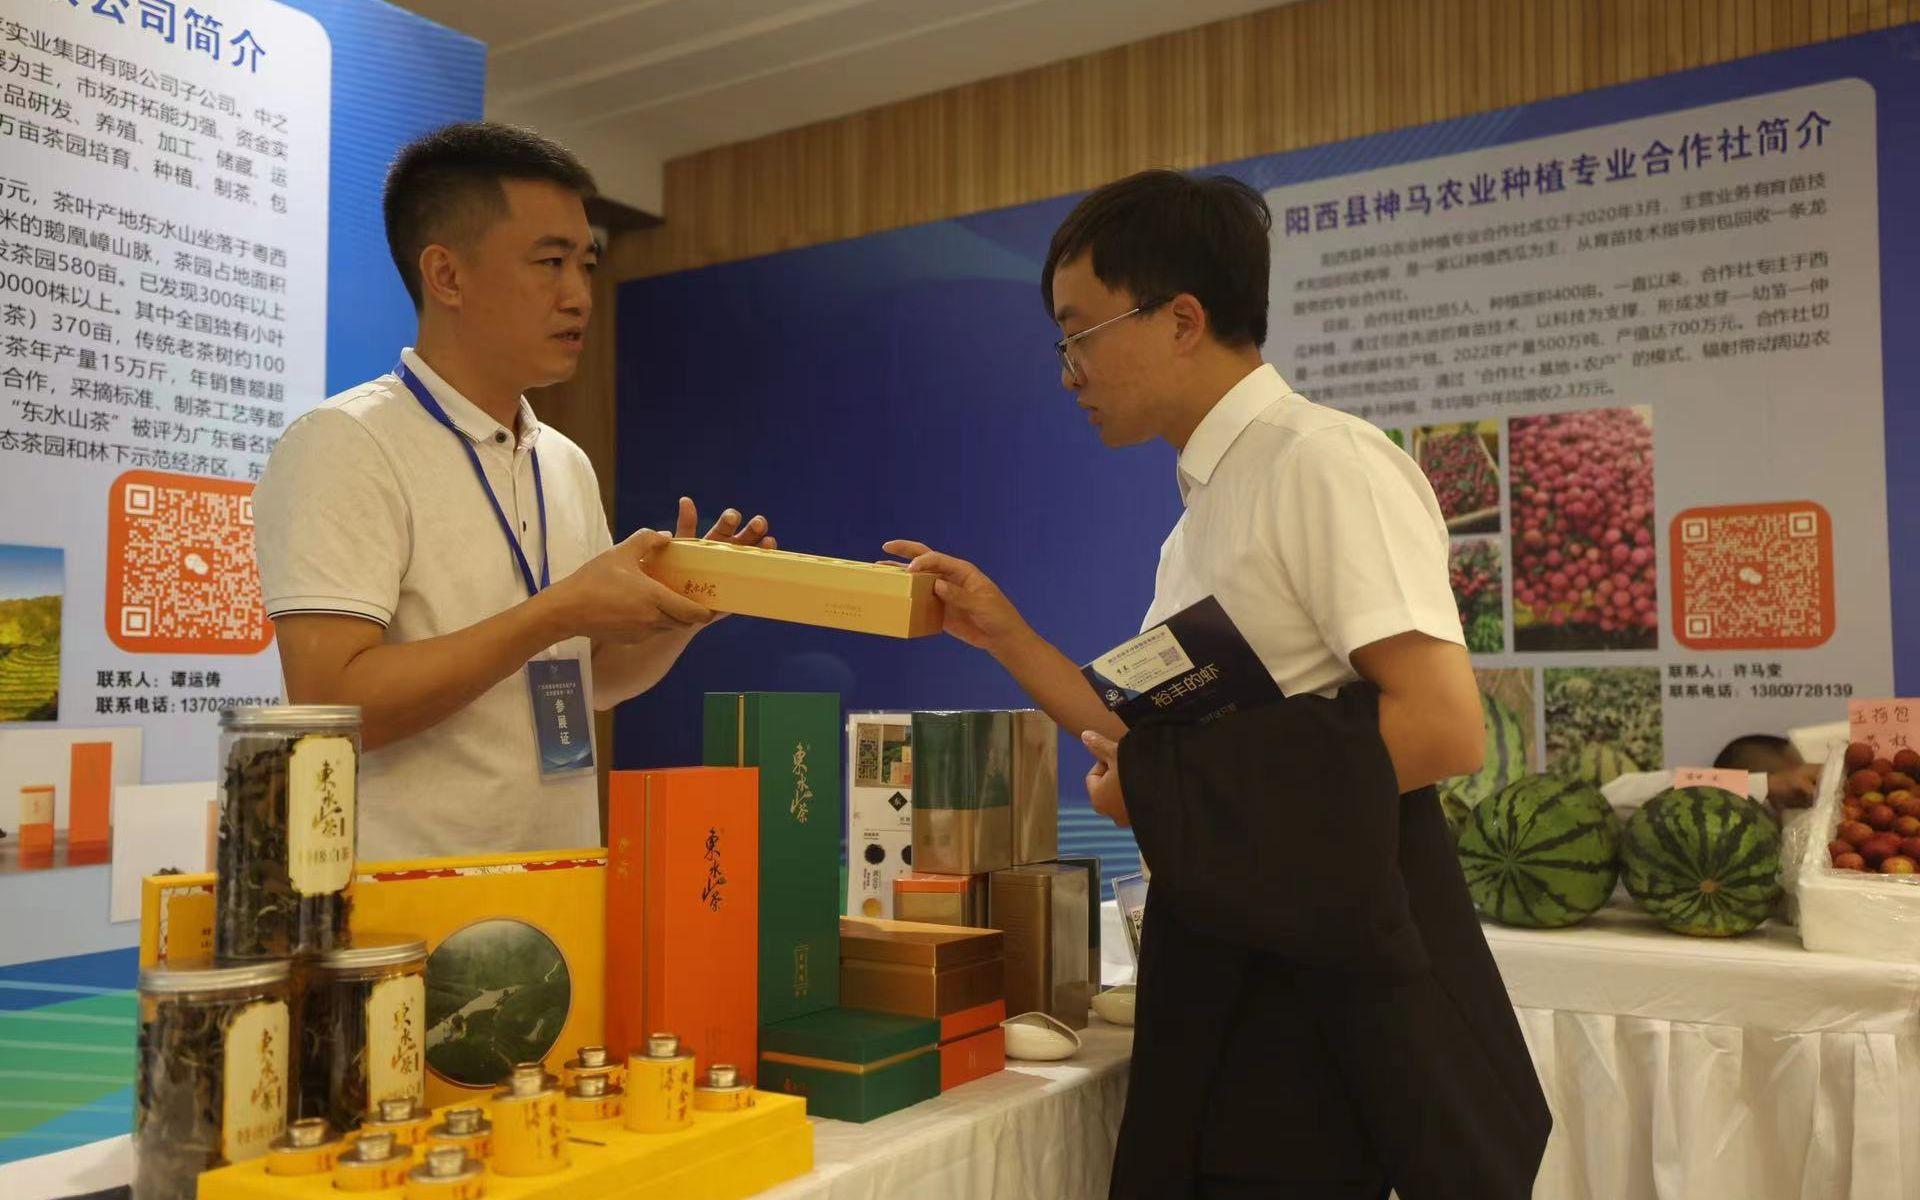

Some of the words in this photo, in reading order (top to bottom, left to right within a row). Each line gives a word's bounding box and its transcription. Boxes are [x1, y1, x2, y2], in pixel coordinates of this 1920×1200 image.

[64, 0, 266, 73] 公司简介
[1285, 110, 1831, 236] 阳西县神马农业种植专业合作社简介
[0, 176, 287, 268] 元，茶叶产地东水山坐落于粤西
[0, 335, 284, 402] 茶年产量15万斤，年销售额超
